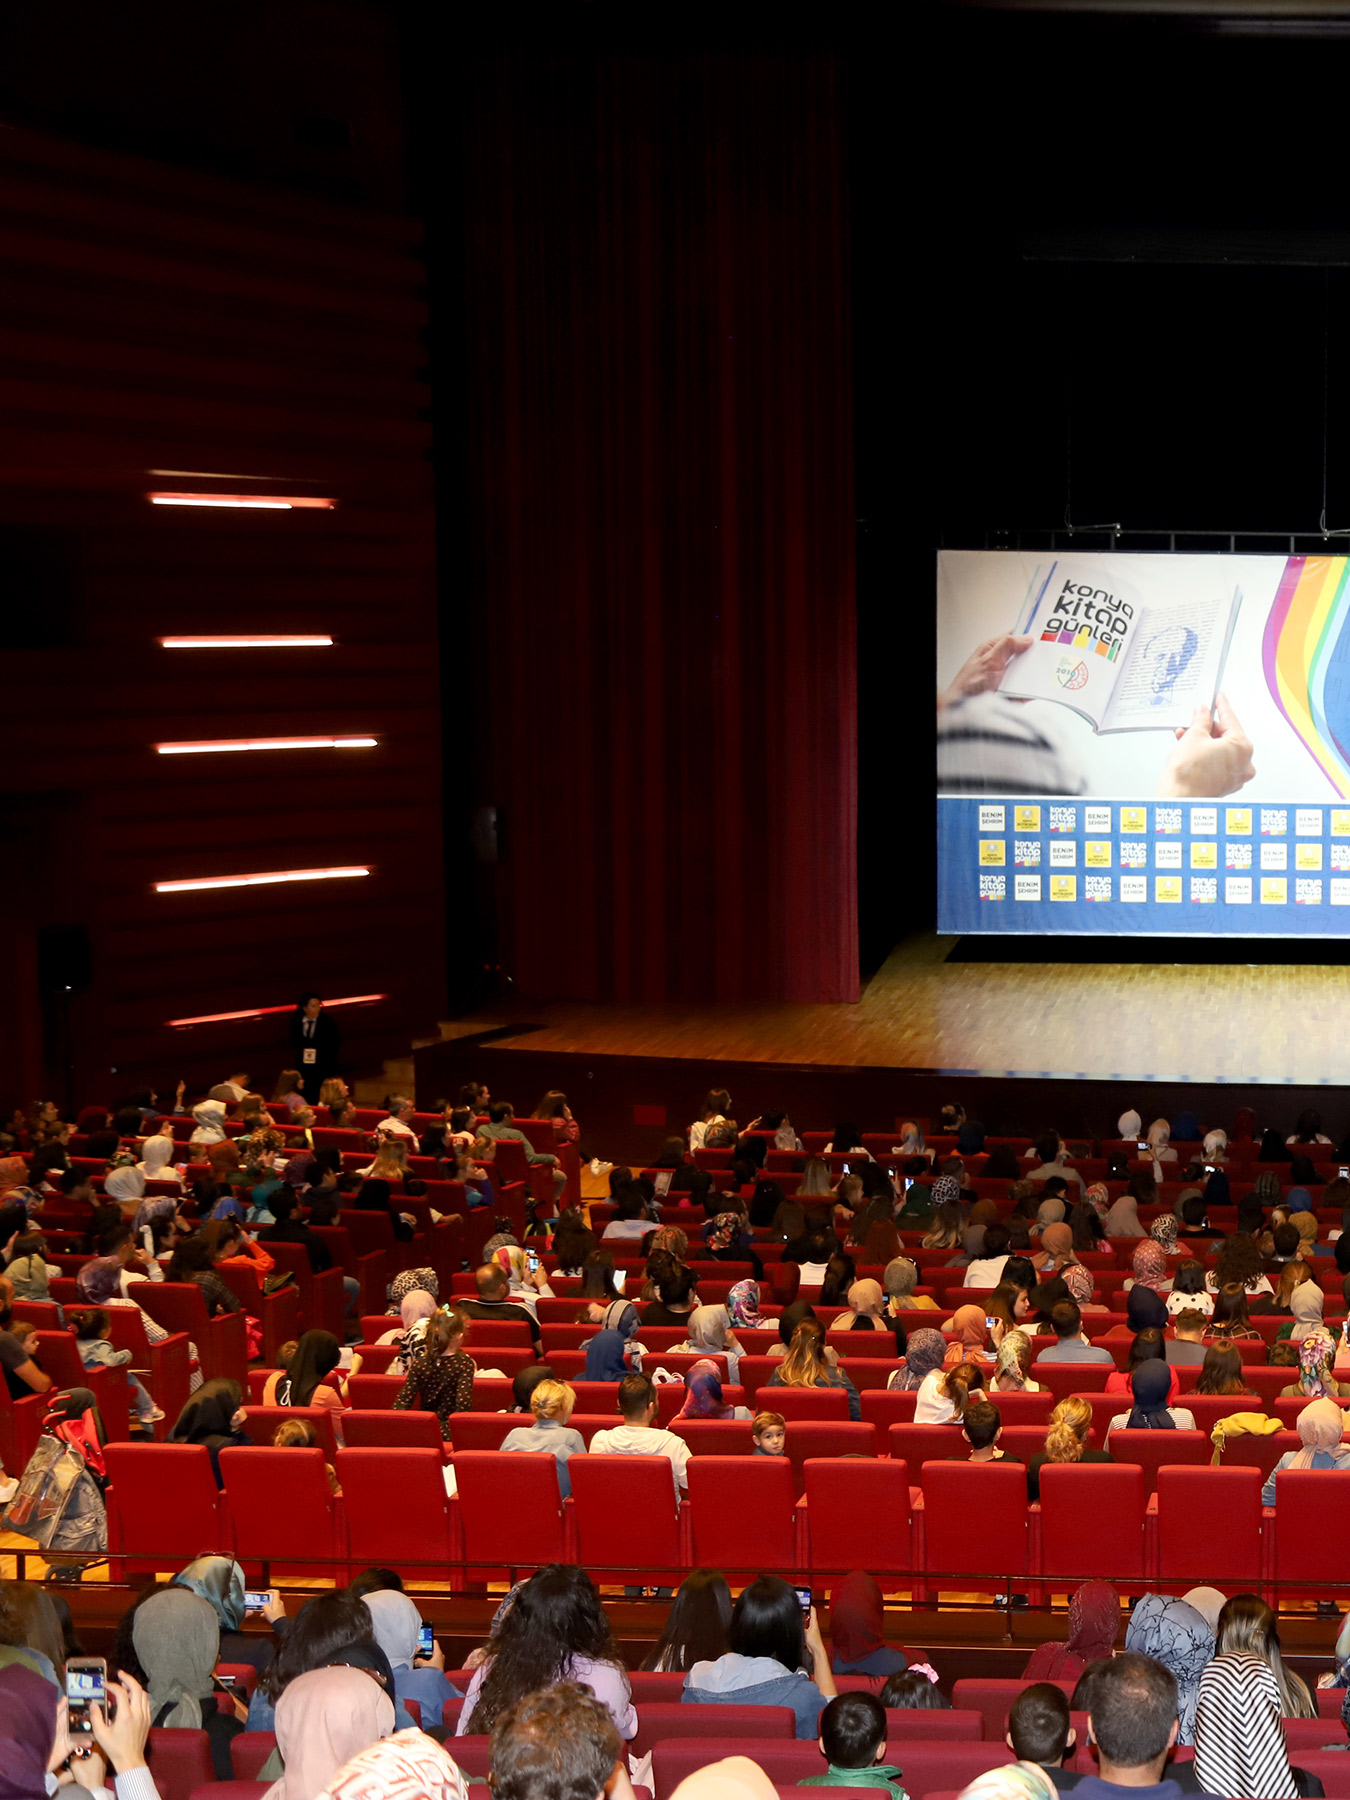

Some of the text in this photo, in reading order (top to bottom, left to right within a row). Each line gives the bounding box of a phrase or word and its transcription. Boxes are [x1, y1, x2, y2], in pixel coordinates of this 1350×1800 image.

[1053, 596, 1128, 636] kitap
[1062, 579, 1134, 620] konya
[1044, 617, 1124, 652] günleri
